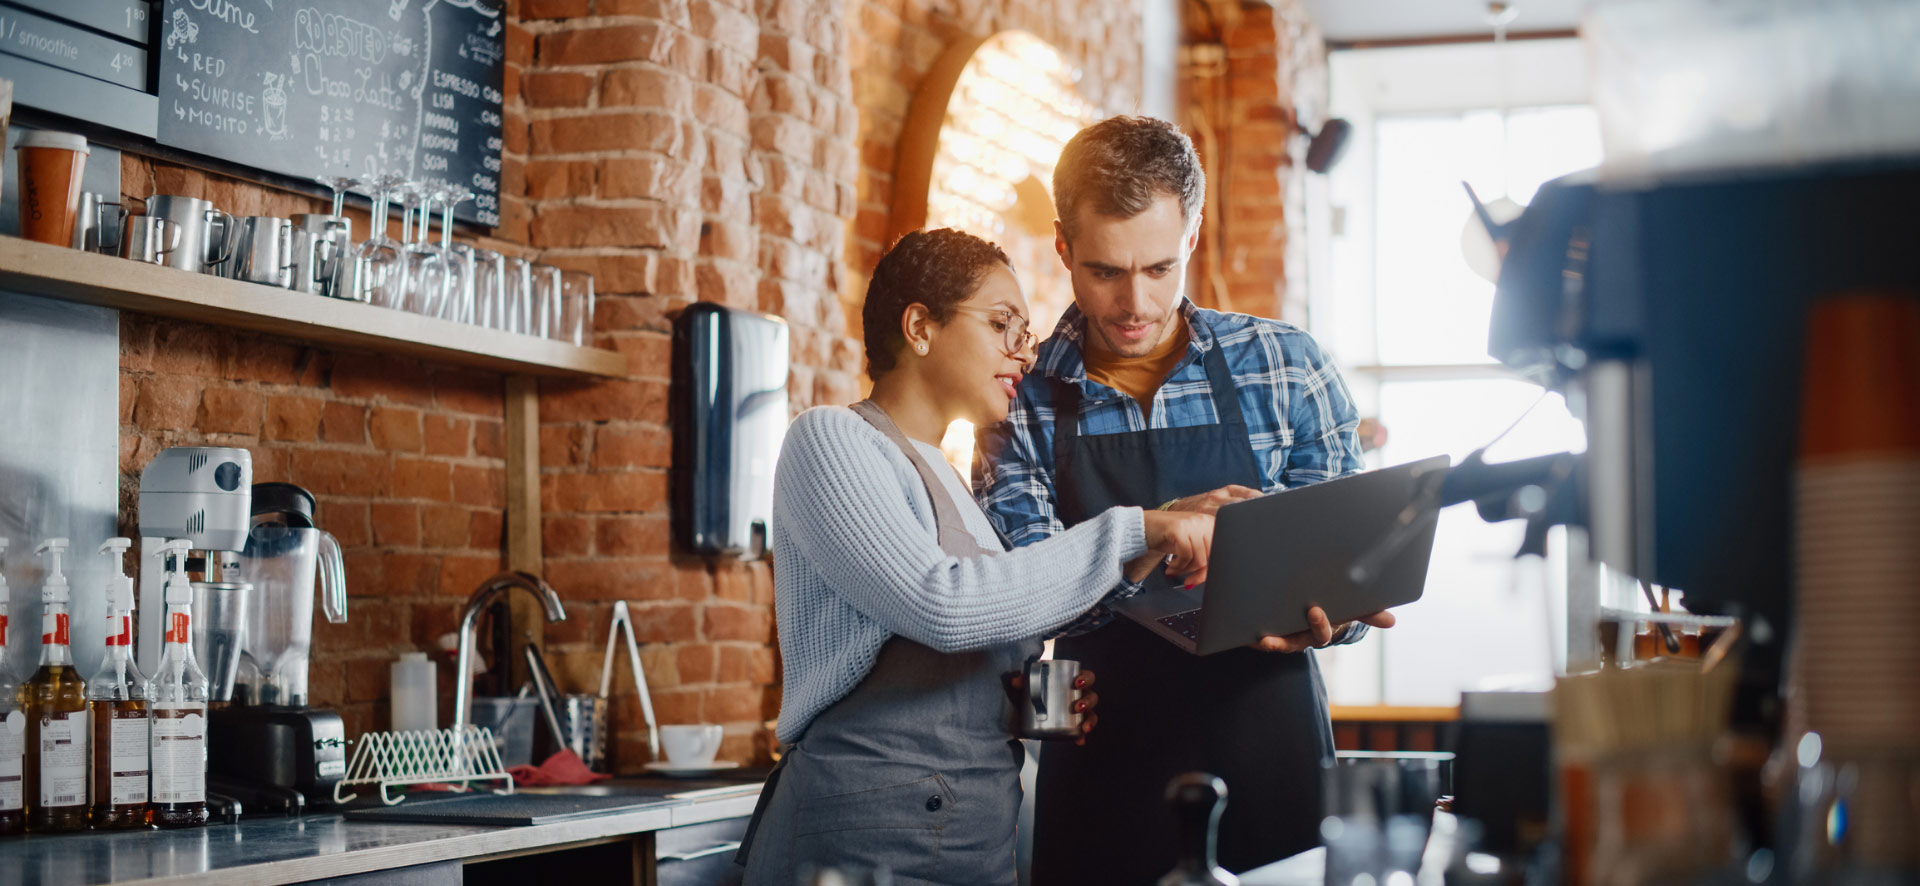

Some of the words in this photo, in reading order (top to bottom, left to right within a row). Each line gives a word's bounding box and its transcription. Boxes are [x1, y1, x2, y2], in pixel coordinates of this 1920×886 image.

[18, 30, 79, 60] smoothie
[295, 7, 387, 64] ROASTED
[193, 53, 225, 77] RED
[191, 79, 255, 115] SUNRISE
[433, 69, 480, 98] ESPRESSO
[189, 107, 247, 134] MOJITO
